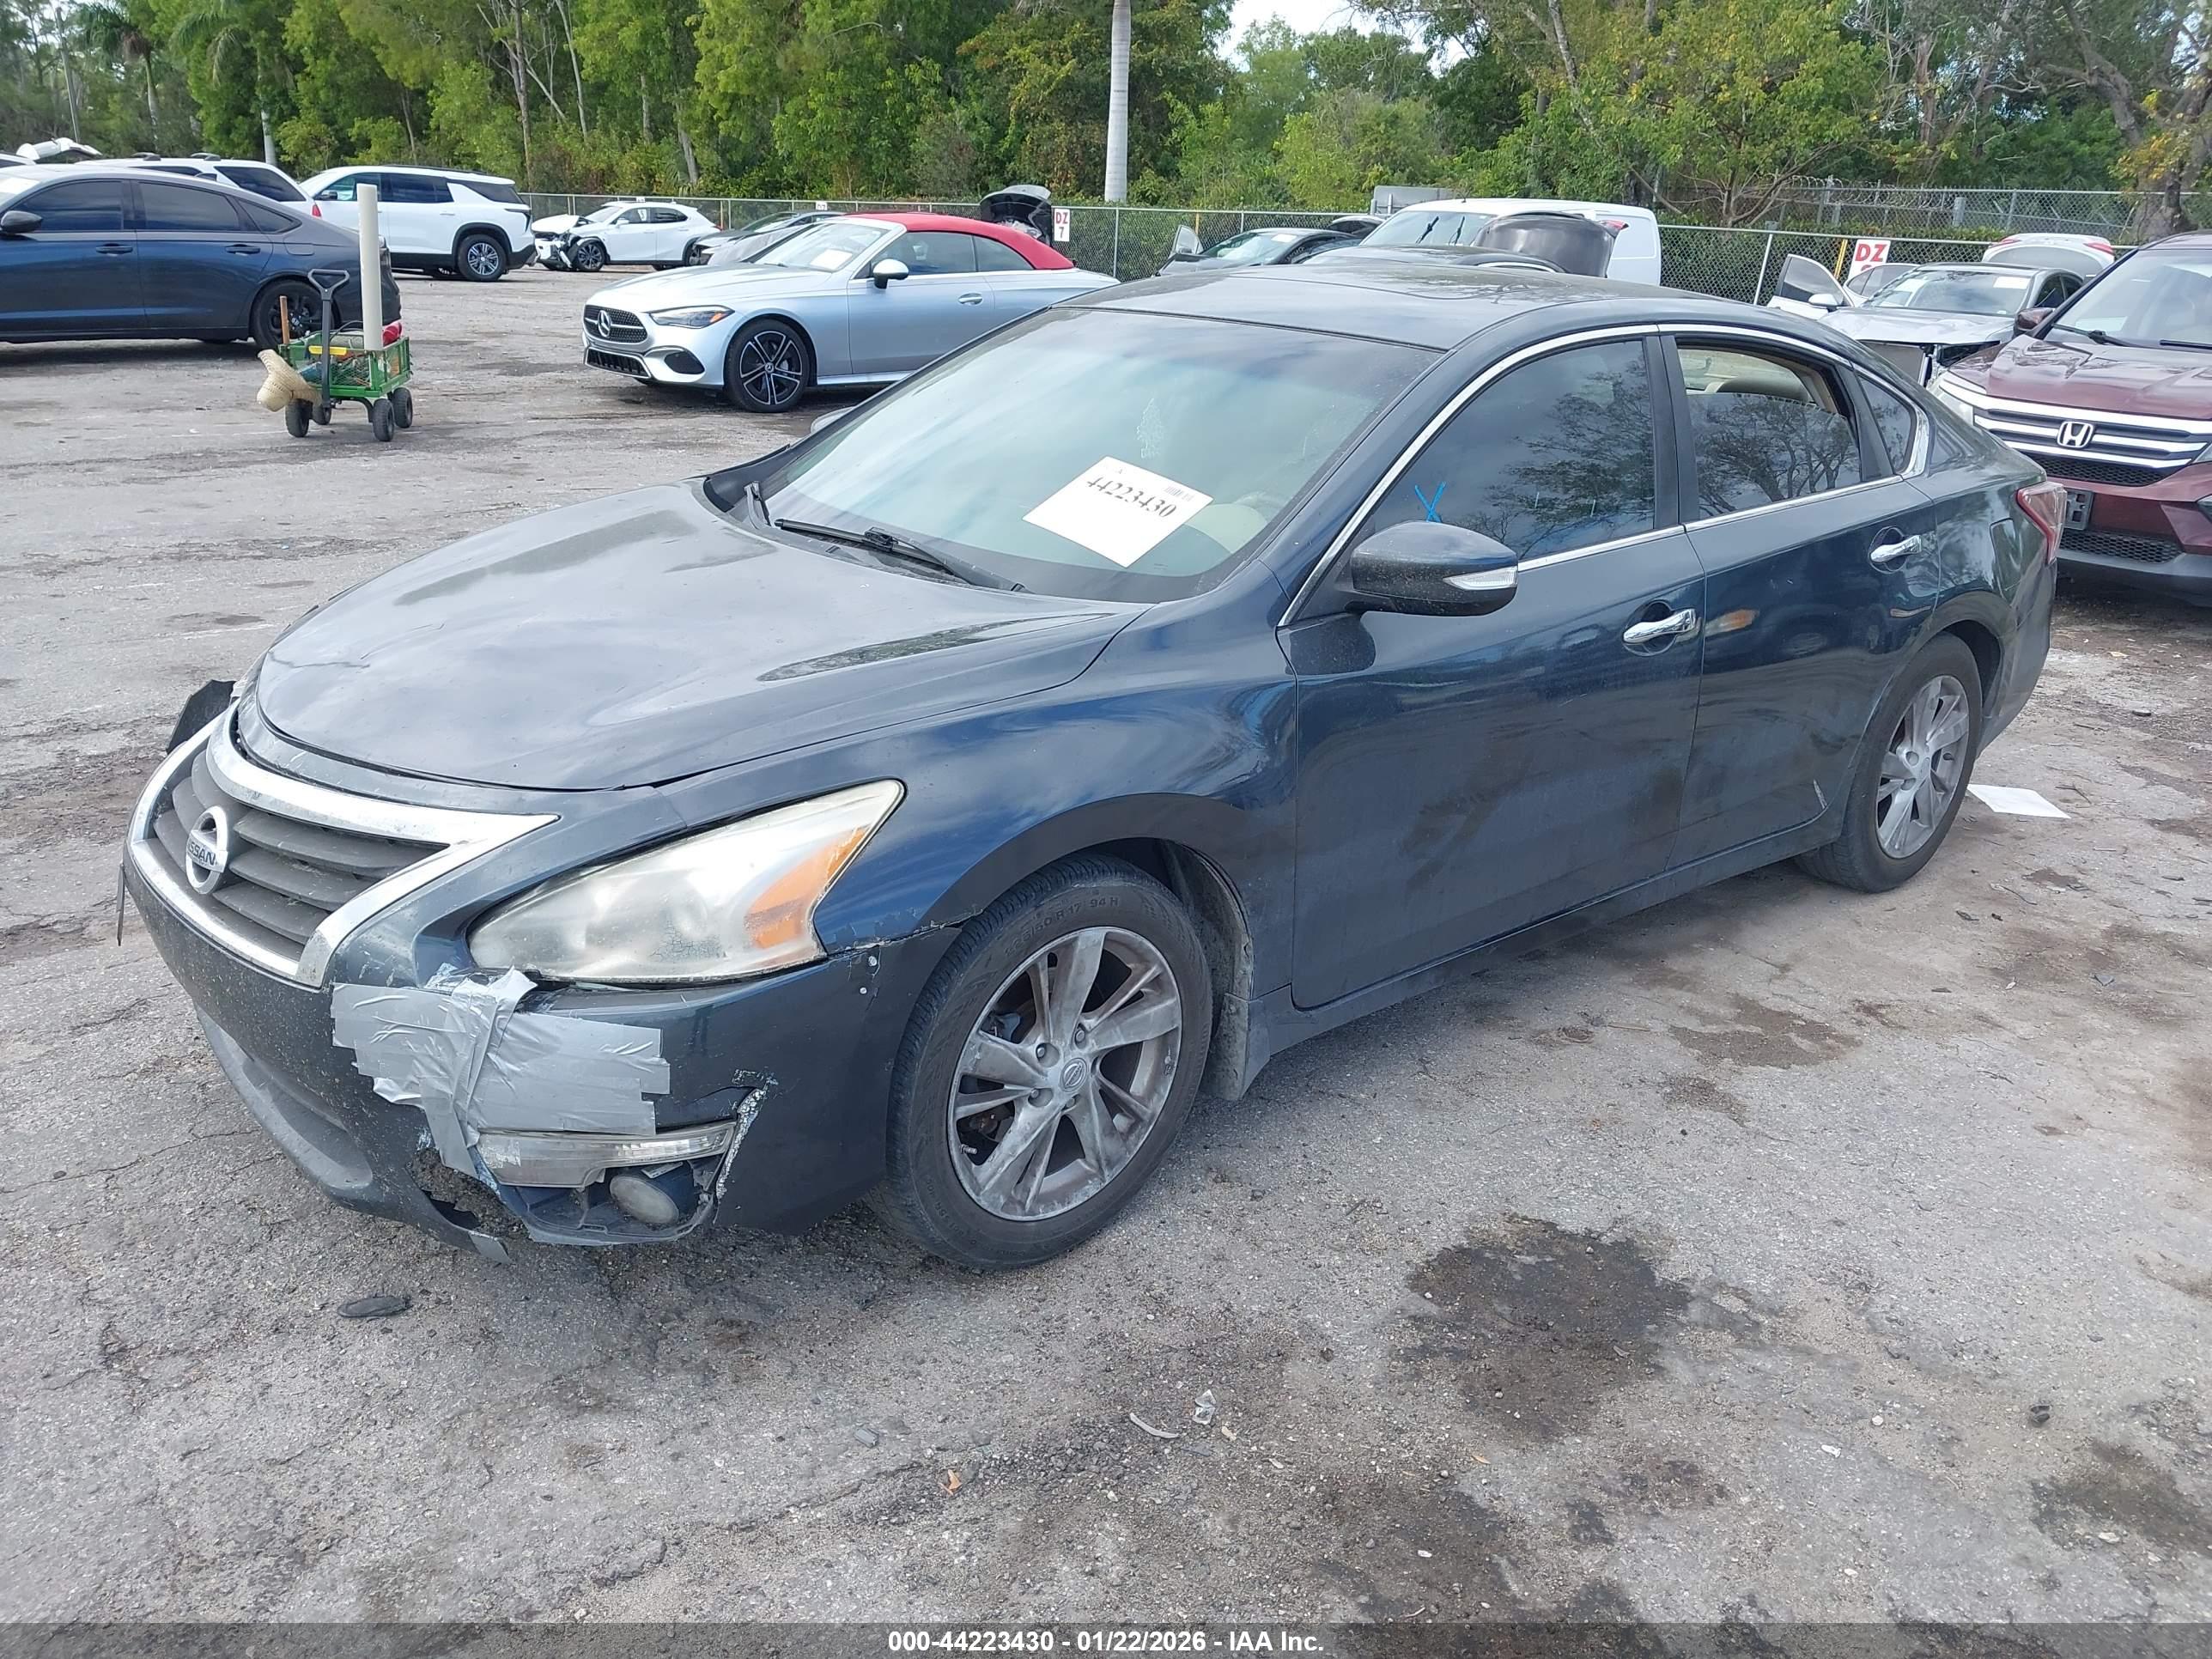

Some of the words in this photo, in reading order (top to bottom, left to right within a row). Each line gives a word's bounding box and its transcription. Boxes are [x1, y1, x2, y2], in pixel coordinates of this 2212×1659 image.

[1055, 211, 1068, 224] DZ
[1058, 226, 1065, 239] 7
[1855, 243, 1887, 262] DZ
[1086, 475, 1176, 518] 44223430
[187, 840, 216, 866] SSAN
[1090, 897, 1107, 908] 94
[1109, 896, 1120, 907] H
